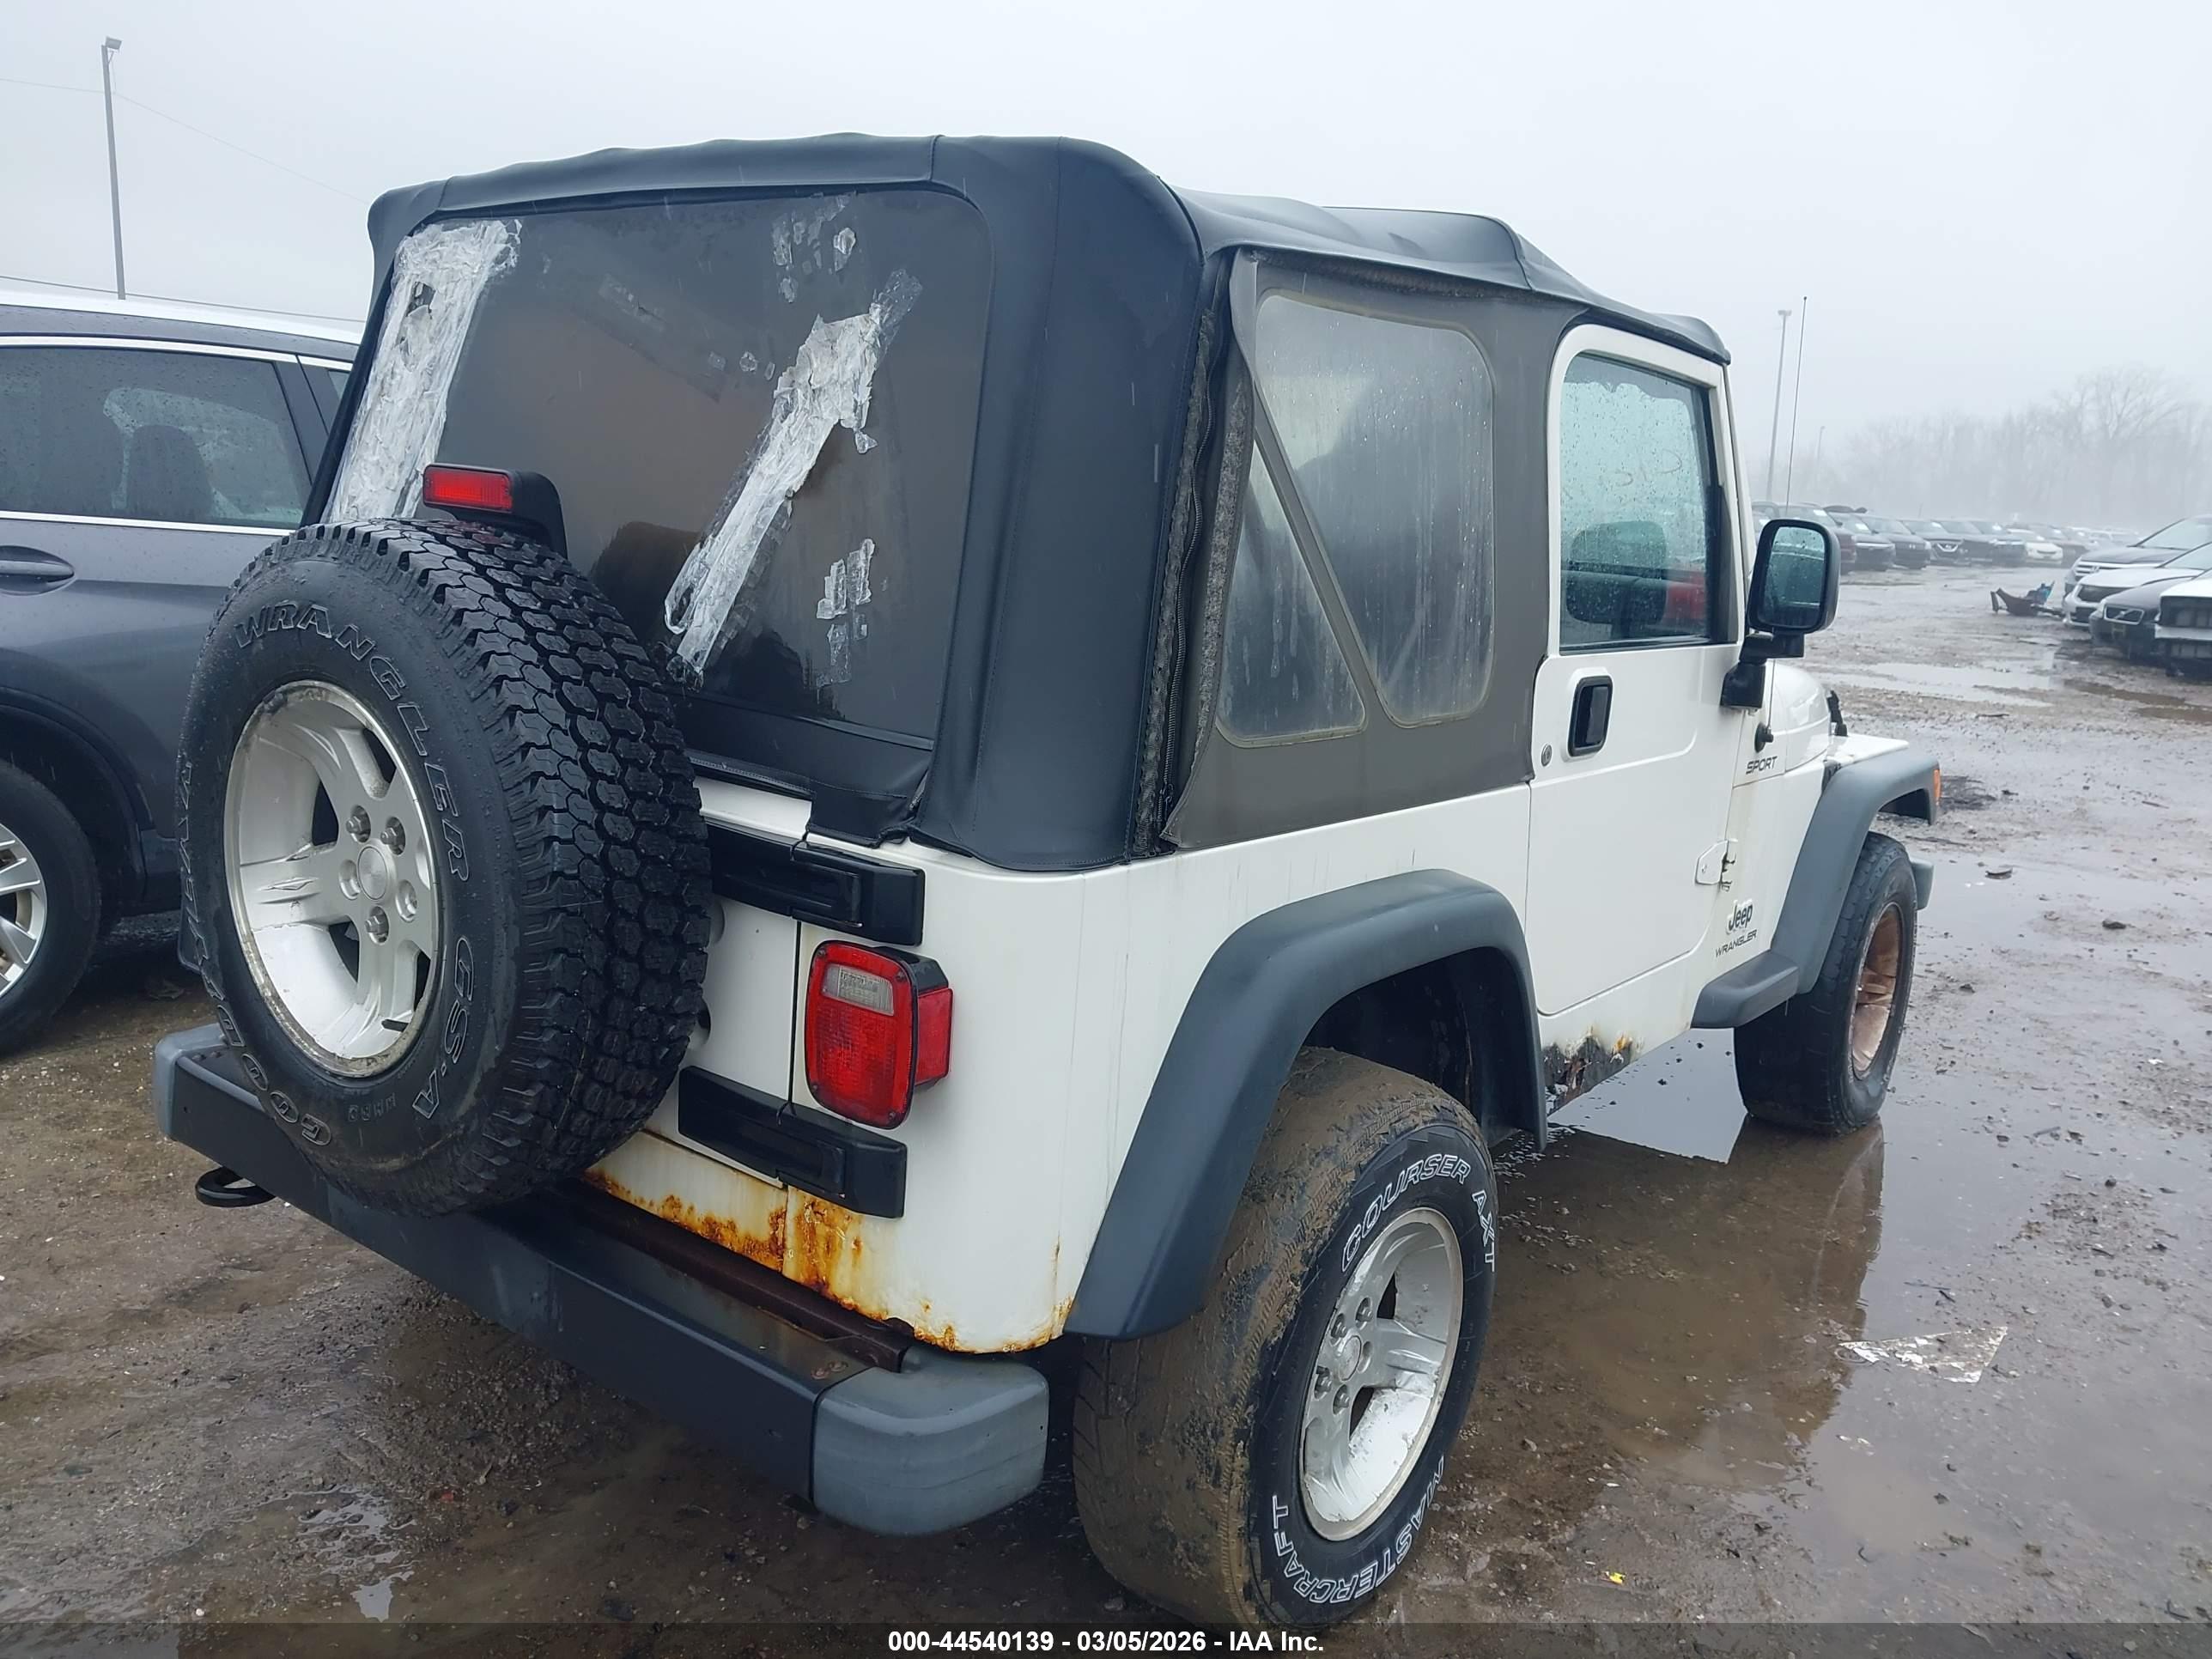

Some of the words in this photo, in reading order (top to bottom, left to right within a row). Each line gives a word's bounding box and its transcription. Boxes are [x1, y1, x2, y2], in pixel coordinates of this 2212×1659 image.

[234, 599, 470, 881] WRANGLER
[1746, 756, 1778, 775] SPORT
[1715, 929, 1758, 958] WRANGLER
[1728, 902, 1753, 932] Jeep
[1341, 1153, 1472, 1273] COURSER
[1471, 1189, 1496, 1273] AXT
[1272, 1455, 1444, 1604] MASTERCRAFT
